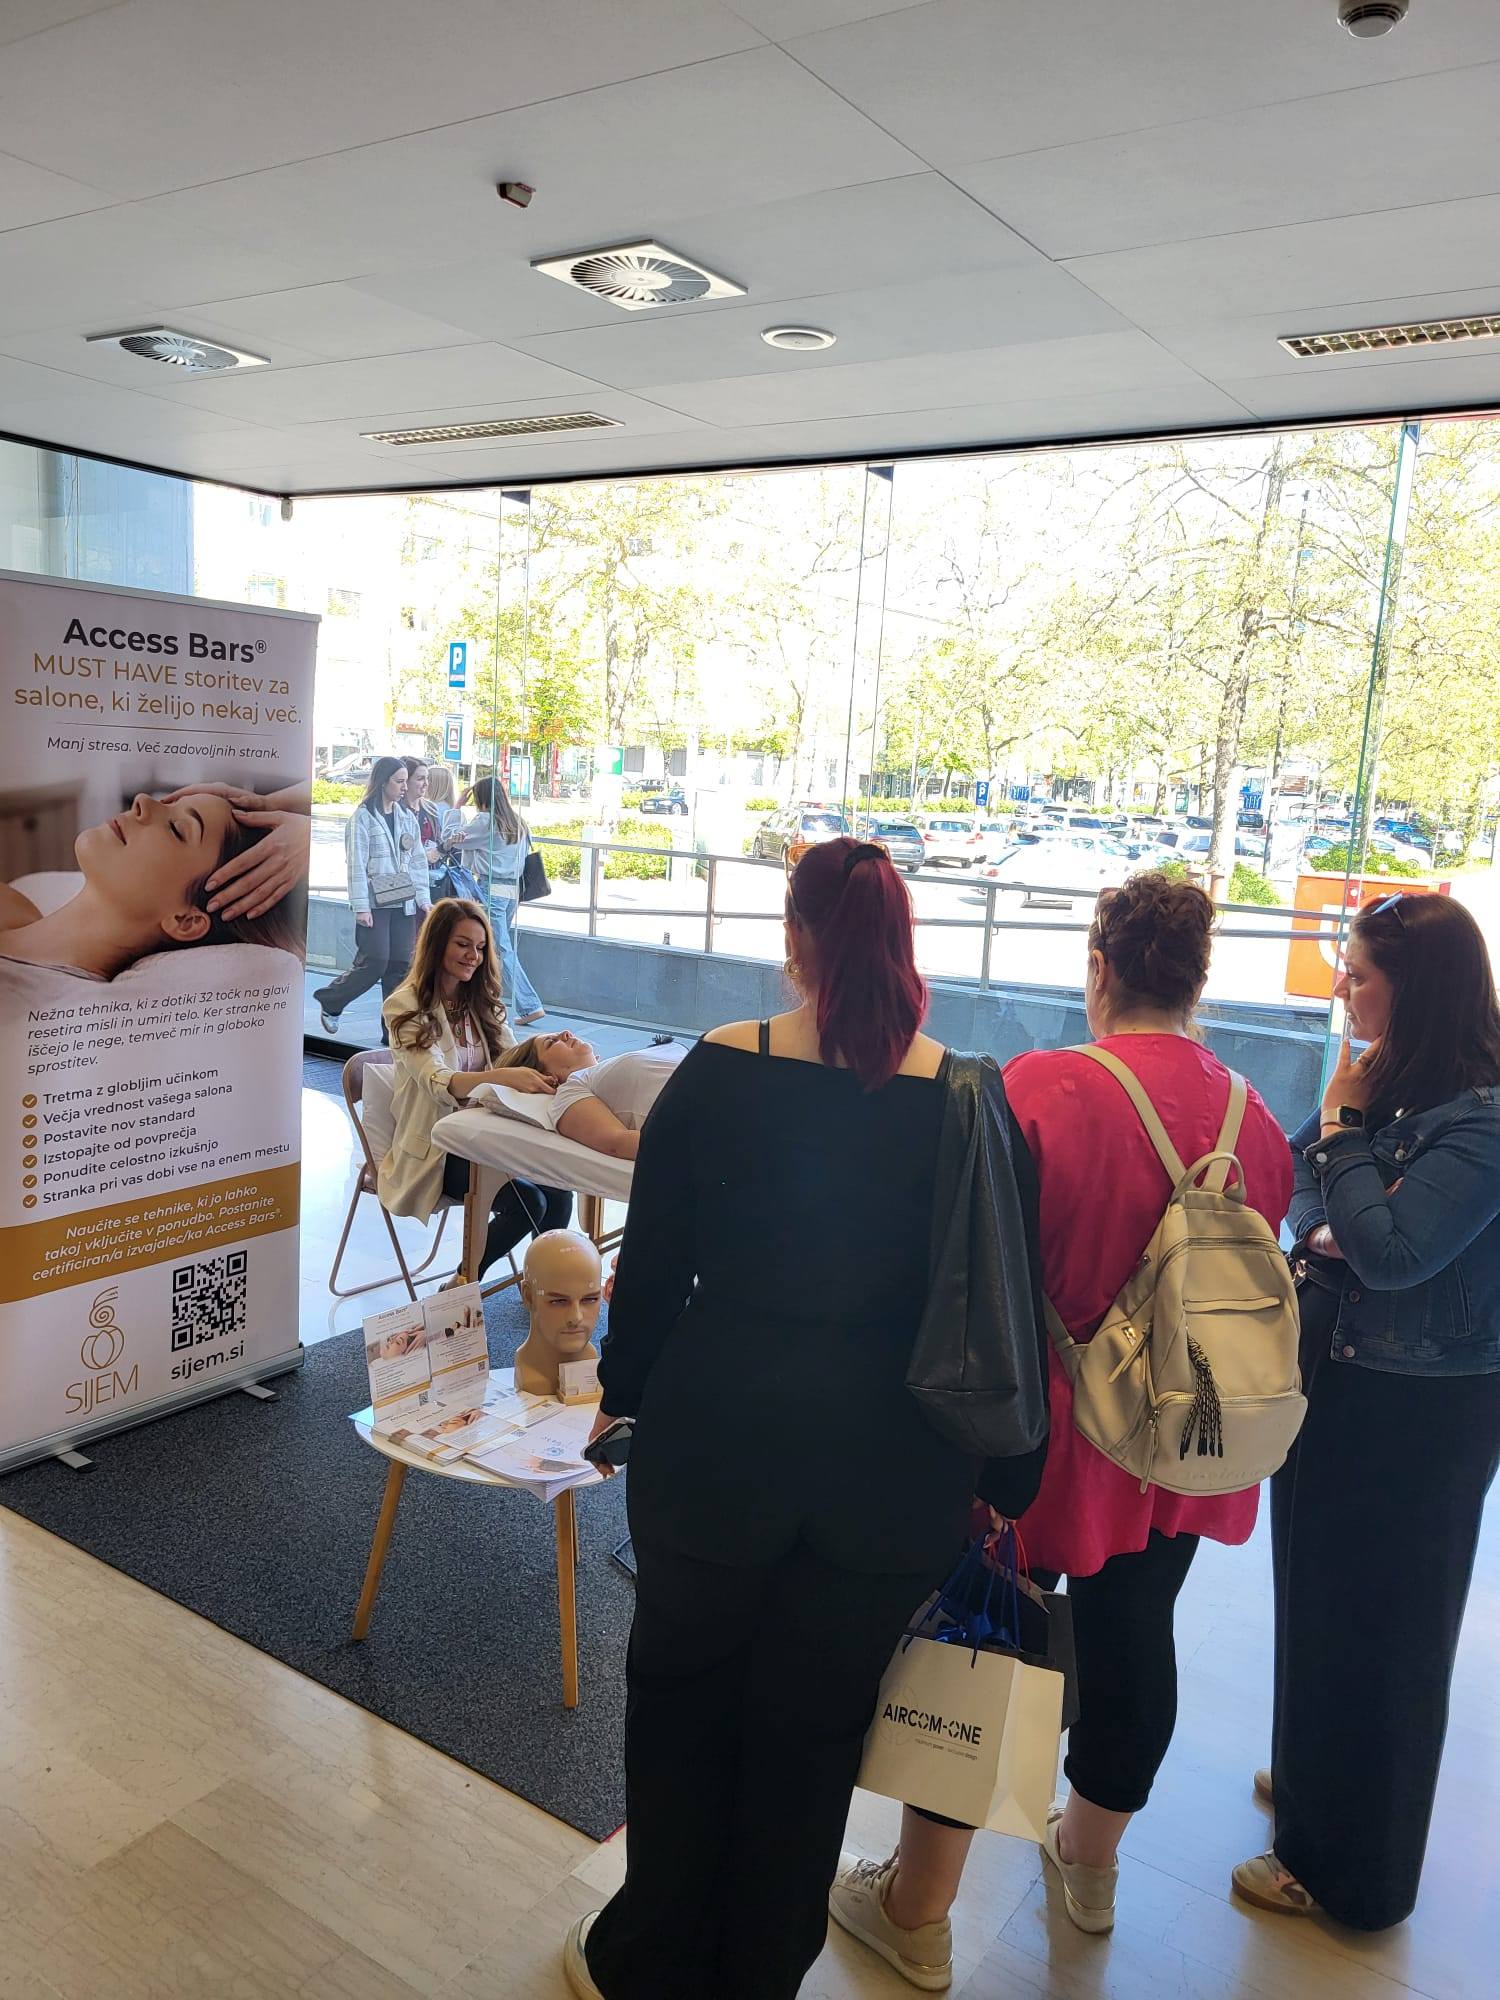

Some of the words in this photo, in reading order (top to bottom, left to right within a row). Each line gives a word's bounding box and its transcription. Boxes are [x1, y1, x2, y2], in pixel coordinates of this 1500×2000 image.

[63, 618, 179, 656] Access
[33, 652, 107, 679] MUST
[114, 660, 178, 685] HAVE
[184, 671, 264, 693] storitev
[268, 679, 290, 695] za
[14, 685, 104, 714] salone,
[112, 691, 130, 711] ki
[137, 693, 195, 720] želijo
[202, 700, 259, 725] nekaj
[264, 705, 302, 723] več.
[47, 737, 85, 752] Manj
[88, 739, 132, 752] stresa.
[136, 741, 161, 753] Več
[164, 743, 236, 758] zadovoljnih
[239, 747, 280, 759] strank.
[28, 1008, 75, 1022] Nežna
[78, 1000, 132, 1017] tehnika,
[136, 998, 149, 1010] ki
[151, 1000, 158, 1009] z
[161, 994, 197, 1008] dotiki
[199, 992, 213, 1003] 32
[216, 989, 241, 1000] točk
[244, 989, 260, 998] na
[262, 984, 290, 999] glavi
[28, 1024, 82, 1039] resetira
[86, 1017, 119, 1032] misli
[121, 1017, 134, 1028] in
[138, 1012, 172, 1026] umiri
[175, 1009, 200, 1021] telo.
[203, 1006, 223, 1018] Ker
[225, 1001, 271, 1016] stranke
[273, 1001, 287, 1010] ne
[28, 1042, 69, 1057] iščejo
[72, 1040, 84, 1051] le
[88, 1036, 124, 1049] nege,
[128, 1028, 177, 1043] temveč
[180, 1024, 200, 1037] mir
[203, 1023, 214, 1034] in
[217, 1017, 265, 1034] globoko
[27, 1056, 98, 1076] sprostitev.
[43, 1088, 93, 1105] Tretma
[96, 1087, 104, 1096] z
[107, 1077, 162, 1096] globljim
[166, 1069, 218, 1085] učinkom
[43, 1109, 80, 1125] Večja
[84, 1099, 144, 1117] vrednost
[148, 1093, 191, 1107] vašega
[194, 1085, 232, 1099] salona
[44, 1124, 107, 1144] Postavite
[111, 1119, 136, 1132] nov
[139, 1107, 195, 1127] standard
[44, 1143, 110, 1164] Izstopajte
[114, 1137, 131, 1150] od
[135, 1126, 197, 1149] povprečja
[43, 1184, 95, 1204] Stranka
[99, 1177, 118, 1193] pri
[121, 1175, 143, 1186] vas
[146, 1166, 175, 1181] dobi
[178, 1163, 198, 1175] vse
[201, 1159, 215, 1169] na
[218, 1151, 251, 1166] enem
[255, 1143, 290, 1158] mestu
[44, 1163, 106, 1184] Ponudite
[110, 1153, 166, 1170] celostno
[169, 1140, 219, 1159] izkušnjo
[44, 1241, 82, 1262] takoj
[85, 1228, 142, 1250] vključite
[146, 1227, 154, 1236] v
[157, 1211, 215, 1236] ponudbo.
[218, 1196, 275, 1218] Postanite
[66, 1218, 121, 1240] Naučite
[124, 1214, 140, 1226] se
[143, 1203, 194, 1221] tehnike,
[197, 1195, 209, 1208] ki
[209, 1193, 222, 1207] jo
[224, 1186, 258, 1201] lahko
[32, 1248, 123, 1281] certificiran/a
[126, 1229, 203, 1257] izvajalec/ka
[205, 1218, 246, 1236] Access
[171, 1340, 244, 1380] sijem.si
[65, 1364, 138, 1415] SIJEM
[883, 1703, 982, 1745] AIRCOM-ONE
